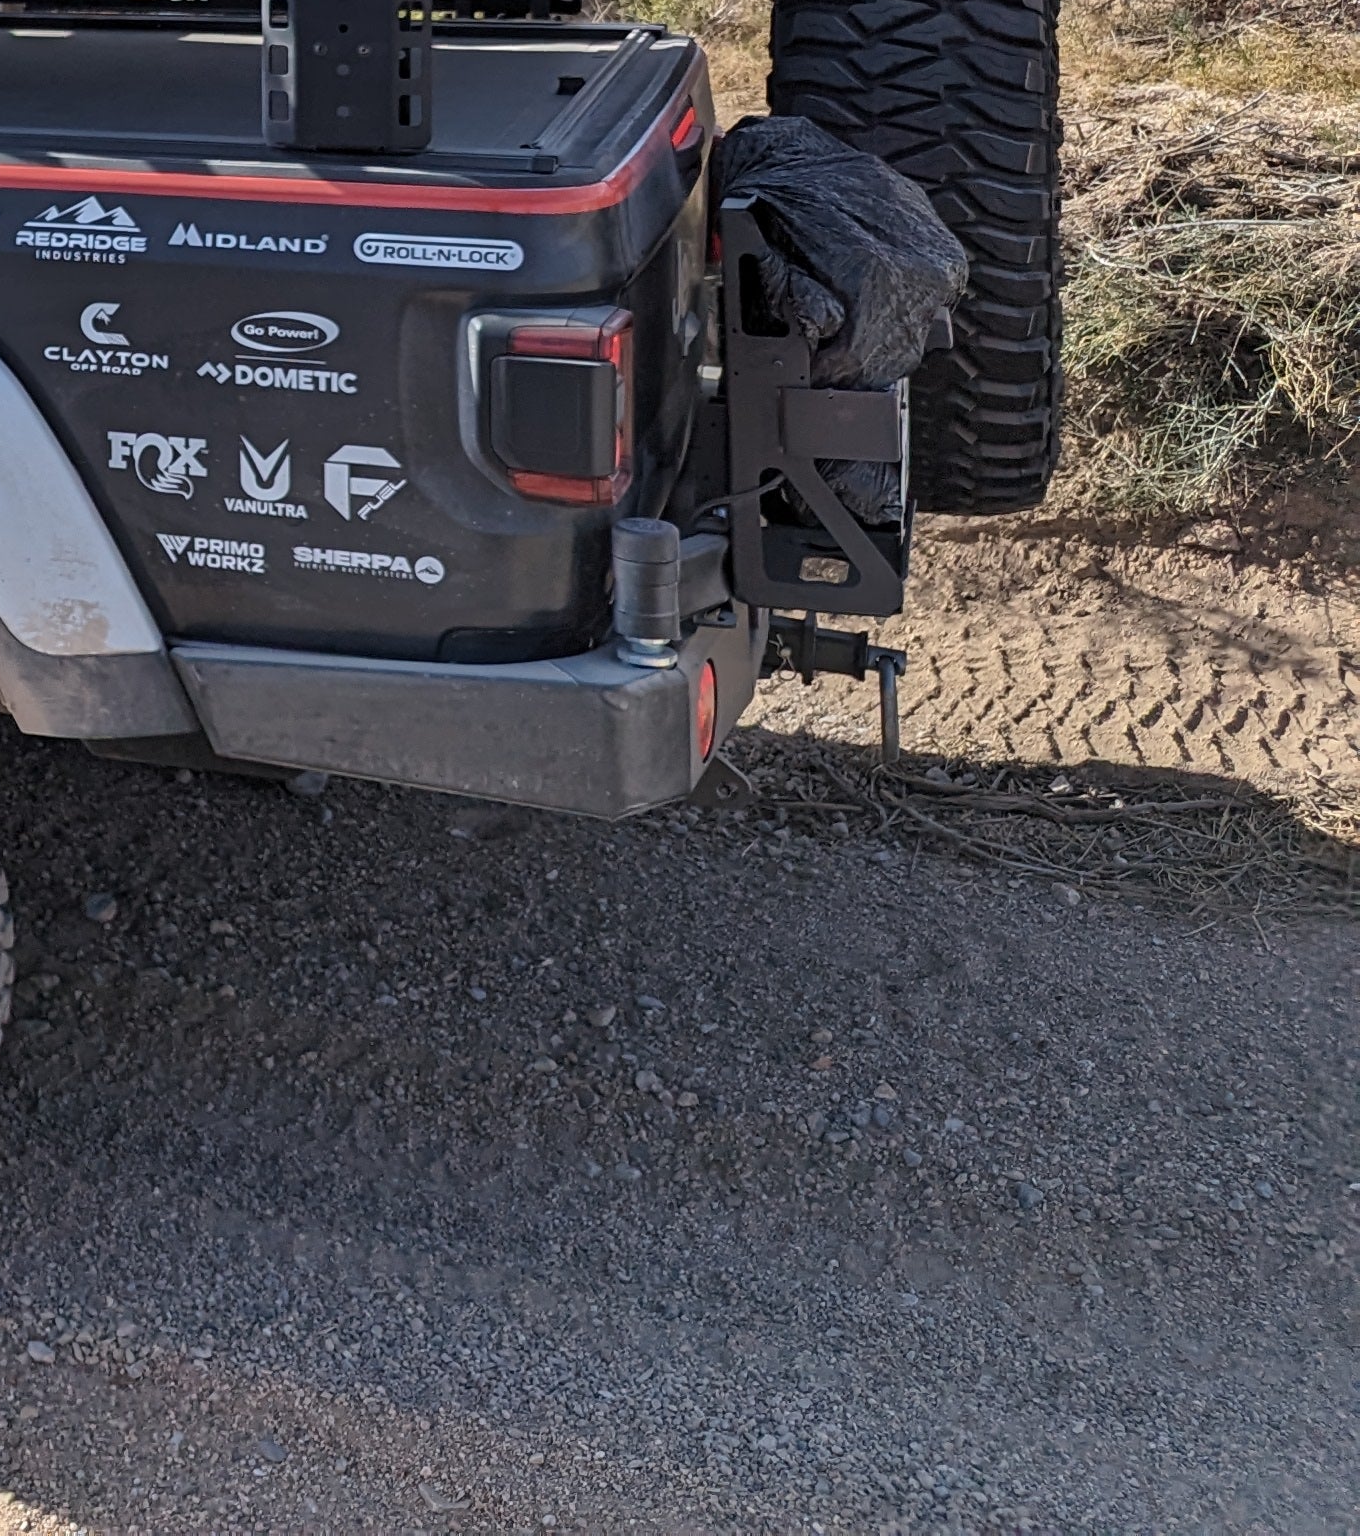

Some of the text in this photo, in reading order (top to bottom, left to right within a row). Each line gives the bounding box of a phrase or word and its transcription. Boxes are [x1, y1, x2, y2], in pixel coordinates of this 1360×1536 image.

[15, 230, 148, 253] REDRIDGE
[167, 222, 328, 254] MIDLAND
[35, 249, 127, 265] INDUSTRIES
[243, 323, 319, 341] Go Power!
[43, 345, 170, 370] CLAYTON
[70, 363, 142, 376] OFF ROAD
[234, 365, 358, 394] DOMETIC
[106, 430, 209, 496] FOX
[223, 497, 309, 520] VANULTRA
[356, 478, 409, 521] FUEL
[193, 536, 265, 558] PRIMO
[186, 551, 266, 574] WORKZ
[292, 545, 412, 573] SHERPA
